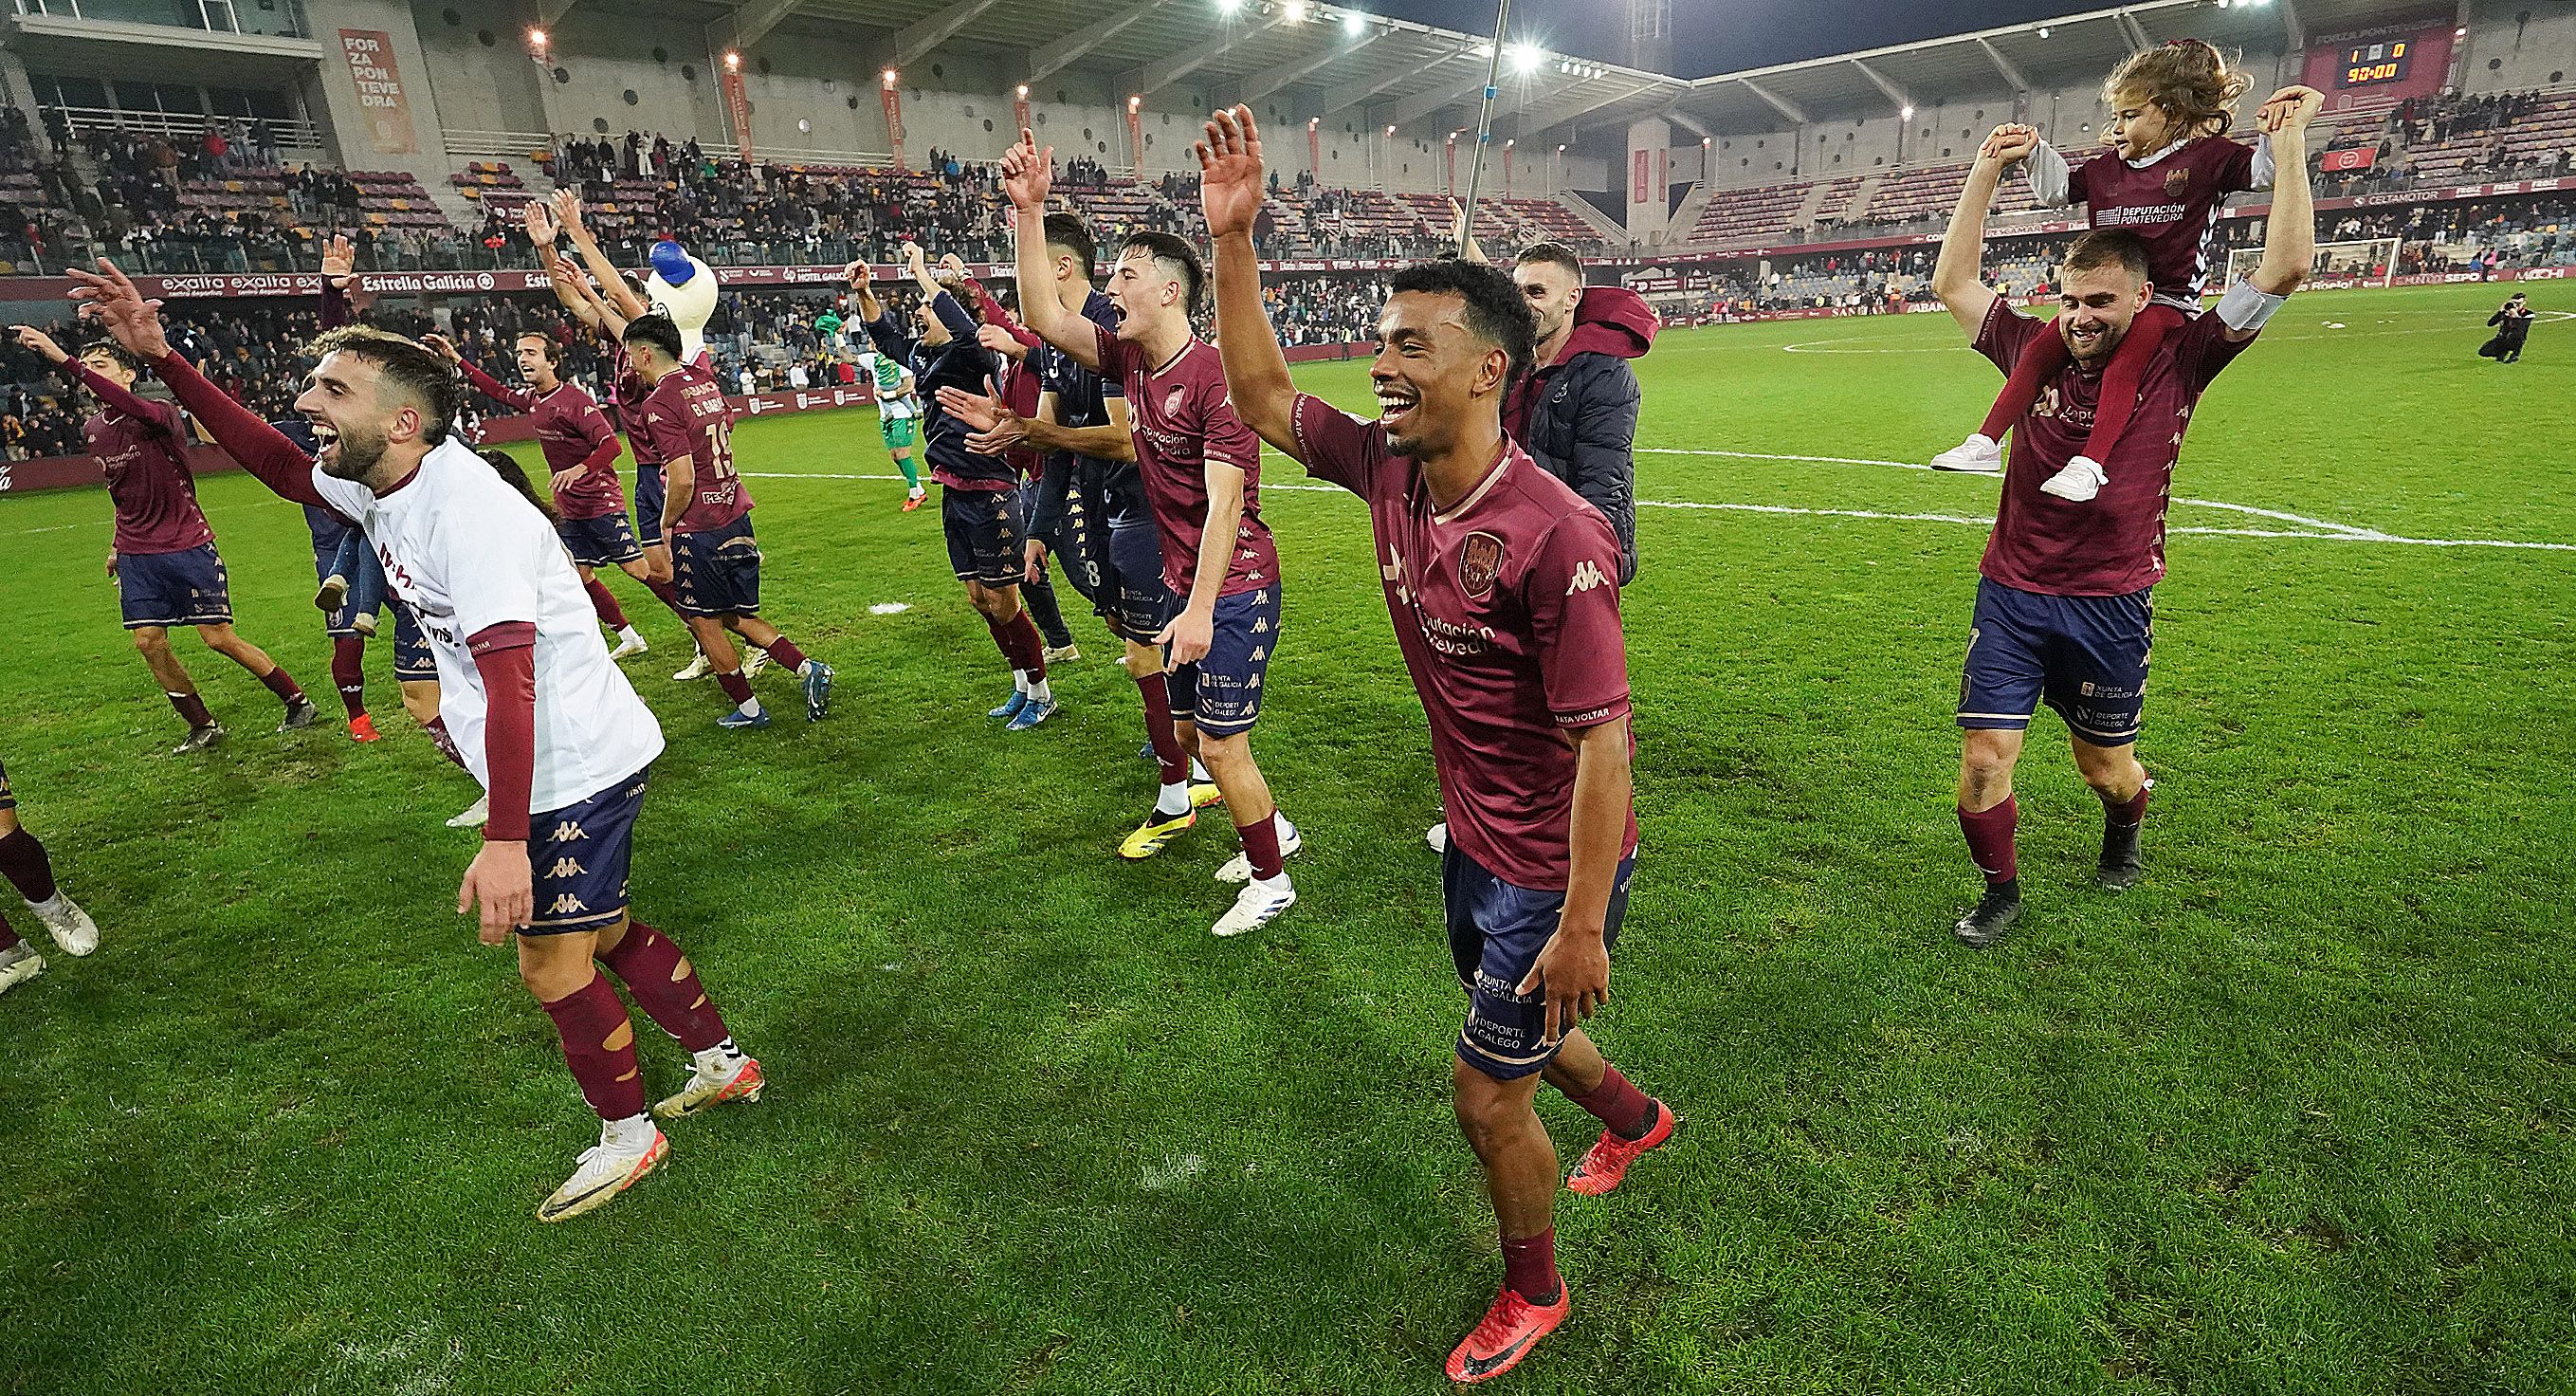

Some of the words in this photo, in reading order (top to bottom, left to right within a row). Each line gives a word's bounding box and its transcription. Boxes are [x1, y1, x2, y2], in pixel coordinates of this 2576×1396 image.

[344, 37, 380, 52] FOR
[2392, 43, 2406, 59] 0
[349, 51, 373, 66] ZA
[353, 65, 390, 80] PON
[356, 81, 400, 95] TEVE
[361, 94, 396, 107] DRA
[2369, 191, 2439, 206] CELTAMOTOR
[2123, 202, 2186, 216] DEPUTACIÓN
[2120, 212, 2183, 225] PONTEVEDRA
[162, 276, 226, 291] exalta
[230, 275, 291, 291] exalta
[361, 274, 422, 292] Estrella
[423, 272, 476, 291] Galicia
[690, 403, 706, 418] B.
[705, 416, 736, 480] 19
[2096, 685, 2124, 693] XUNTA
[1574, 707, 1610, 723] VOLTAR
[2096, 711, 2129, 721] DEPORTE
[1481, 973, 1512, 992] XUNTA
[1491, 987, 1533, 1004] GALICIA
[1479, 1018, 1526, 1038] DEPORTE
[1477, 1029, 1521, 1050] GALEGO
